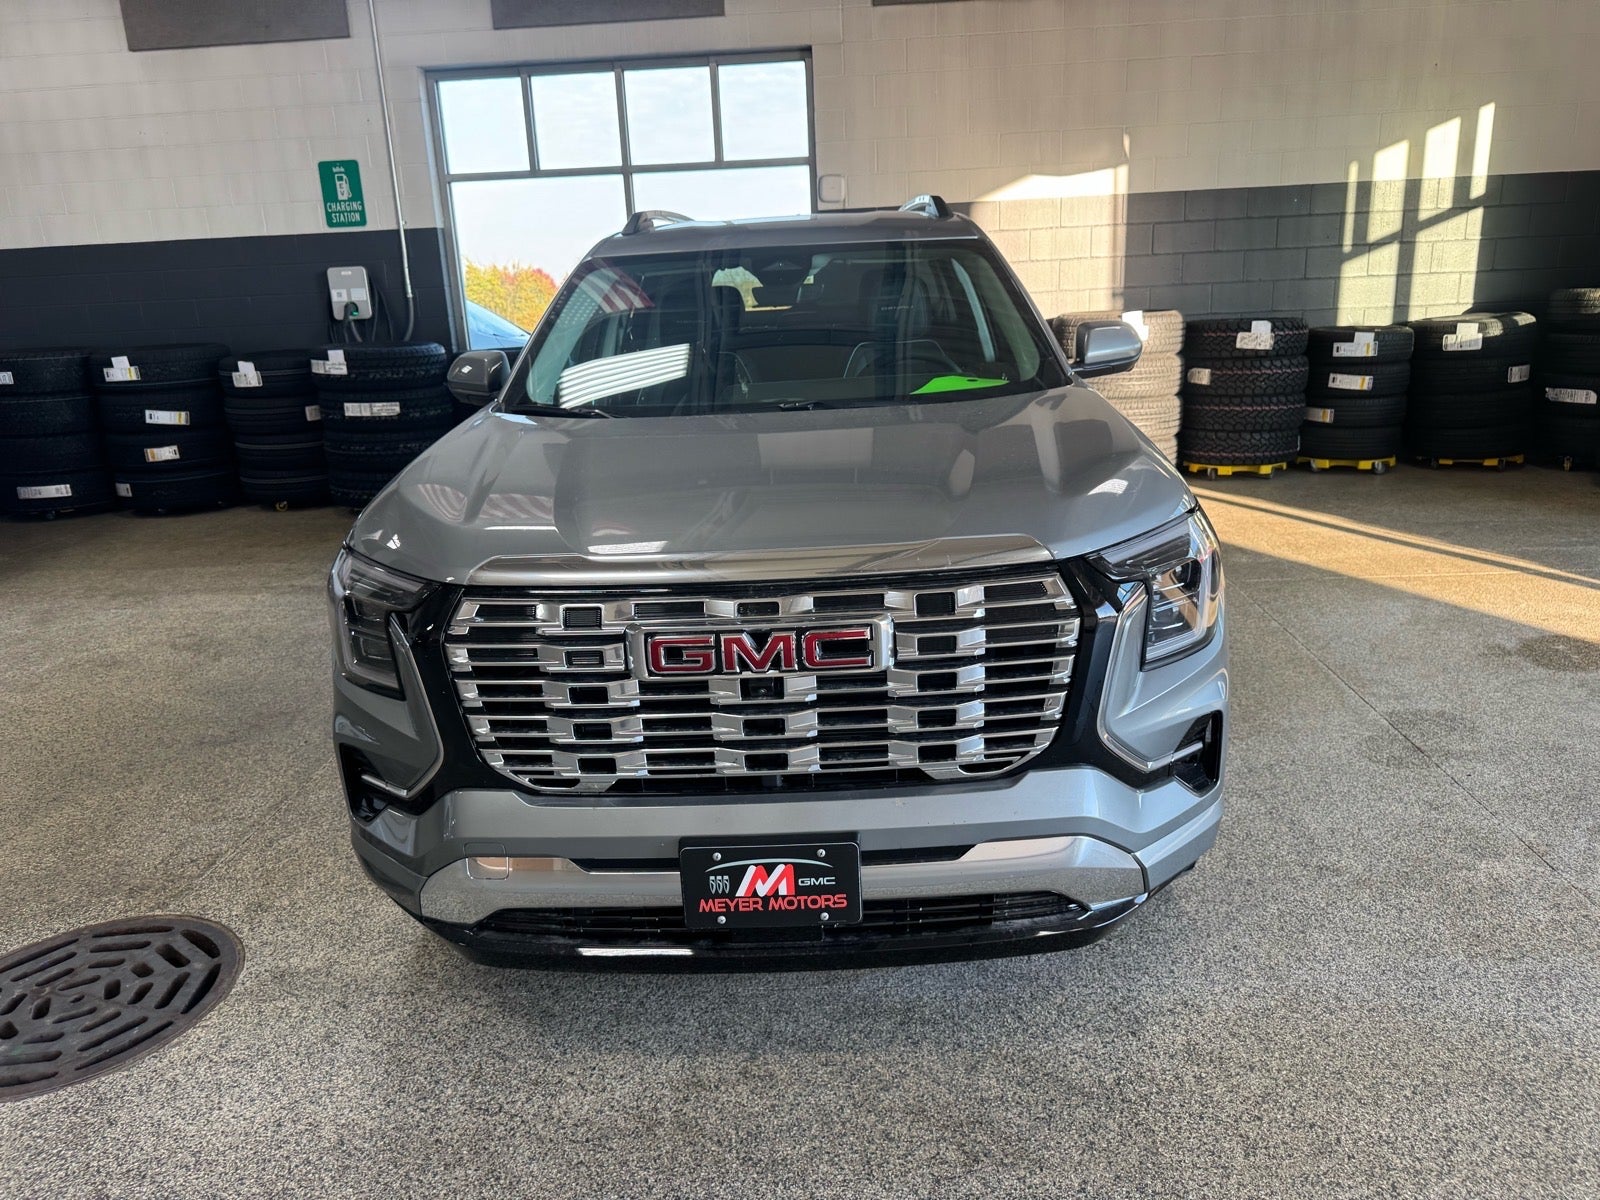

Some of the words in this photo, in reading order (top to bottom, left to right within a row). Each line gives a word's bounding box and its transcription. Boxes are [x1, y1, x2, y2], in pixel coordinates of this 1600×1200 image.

[327, 201, 362, 212] CHARGING
[332, 213, 360, 223] STATION
[648, 627, 873, 673] GMC
[798, 876, 836, 886] GMC
[699, 897, 763, 913] MEYER
[768, 894, 848, 911] MOTORS
